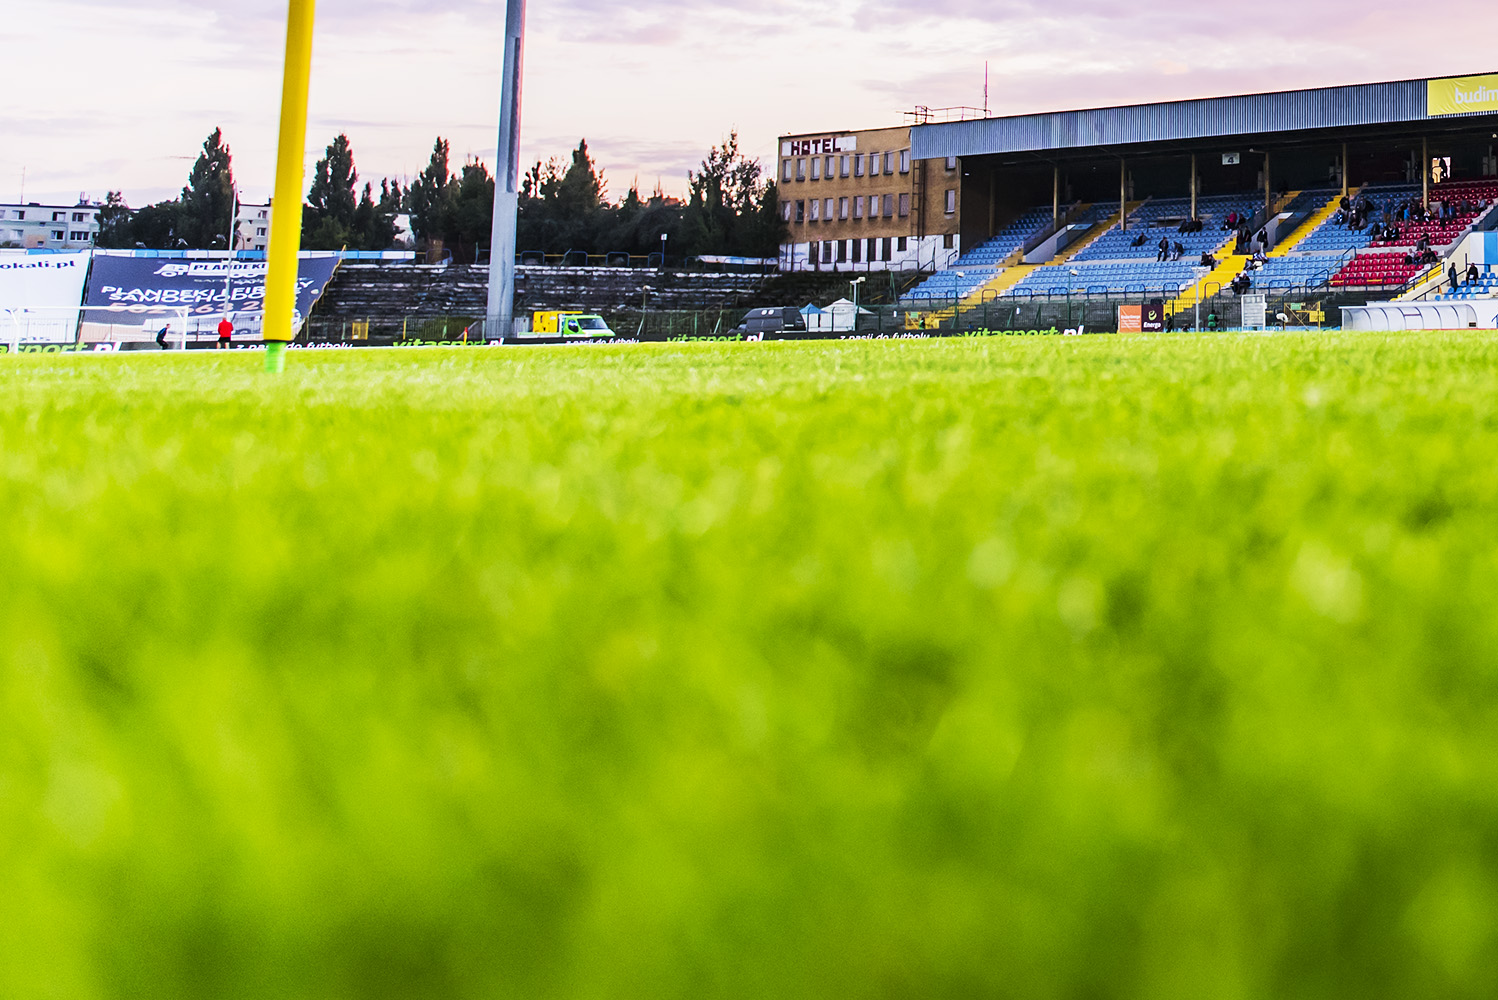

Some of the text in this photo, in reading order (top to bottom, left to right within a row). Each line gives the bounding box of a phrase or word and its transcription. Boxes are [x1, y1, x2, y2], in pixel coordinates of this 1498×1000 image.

[790, 138, 841, 156] HOTEL
[1227, 156, 1235, 164] 4
[193, 262, 266, 272] PLANDEKI
[101, 286, 216, 298] PLANDEKI
